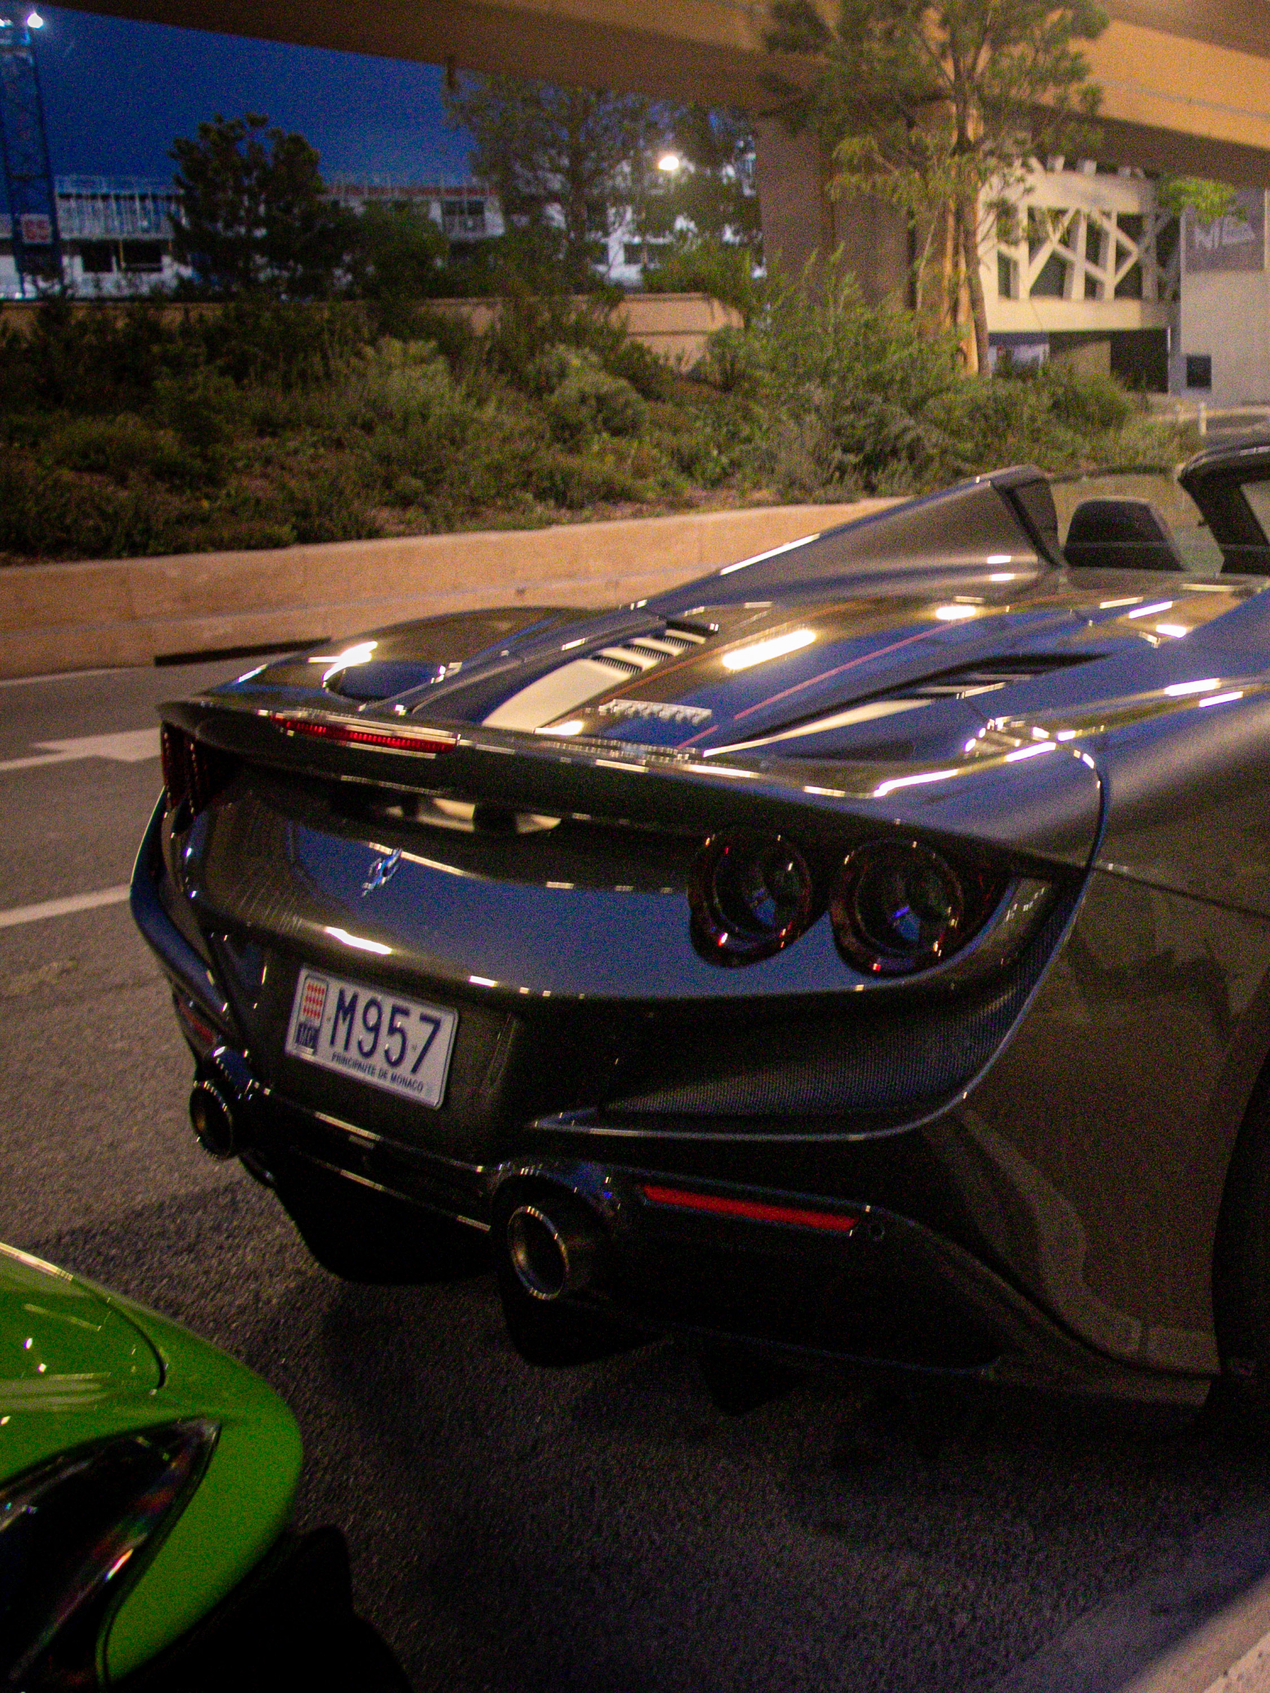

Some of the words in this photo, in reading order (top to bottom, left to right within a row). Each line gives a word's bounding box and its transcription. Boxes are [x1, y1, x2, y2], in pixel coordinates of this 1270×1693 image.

[329, 986, 442, 1075] M957
[378, 1067, 389, 1081] DE
[390, 1069, 424, 1095] MONACO
